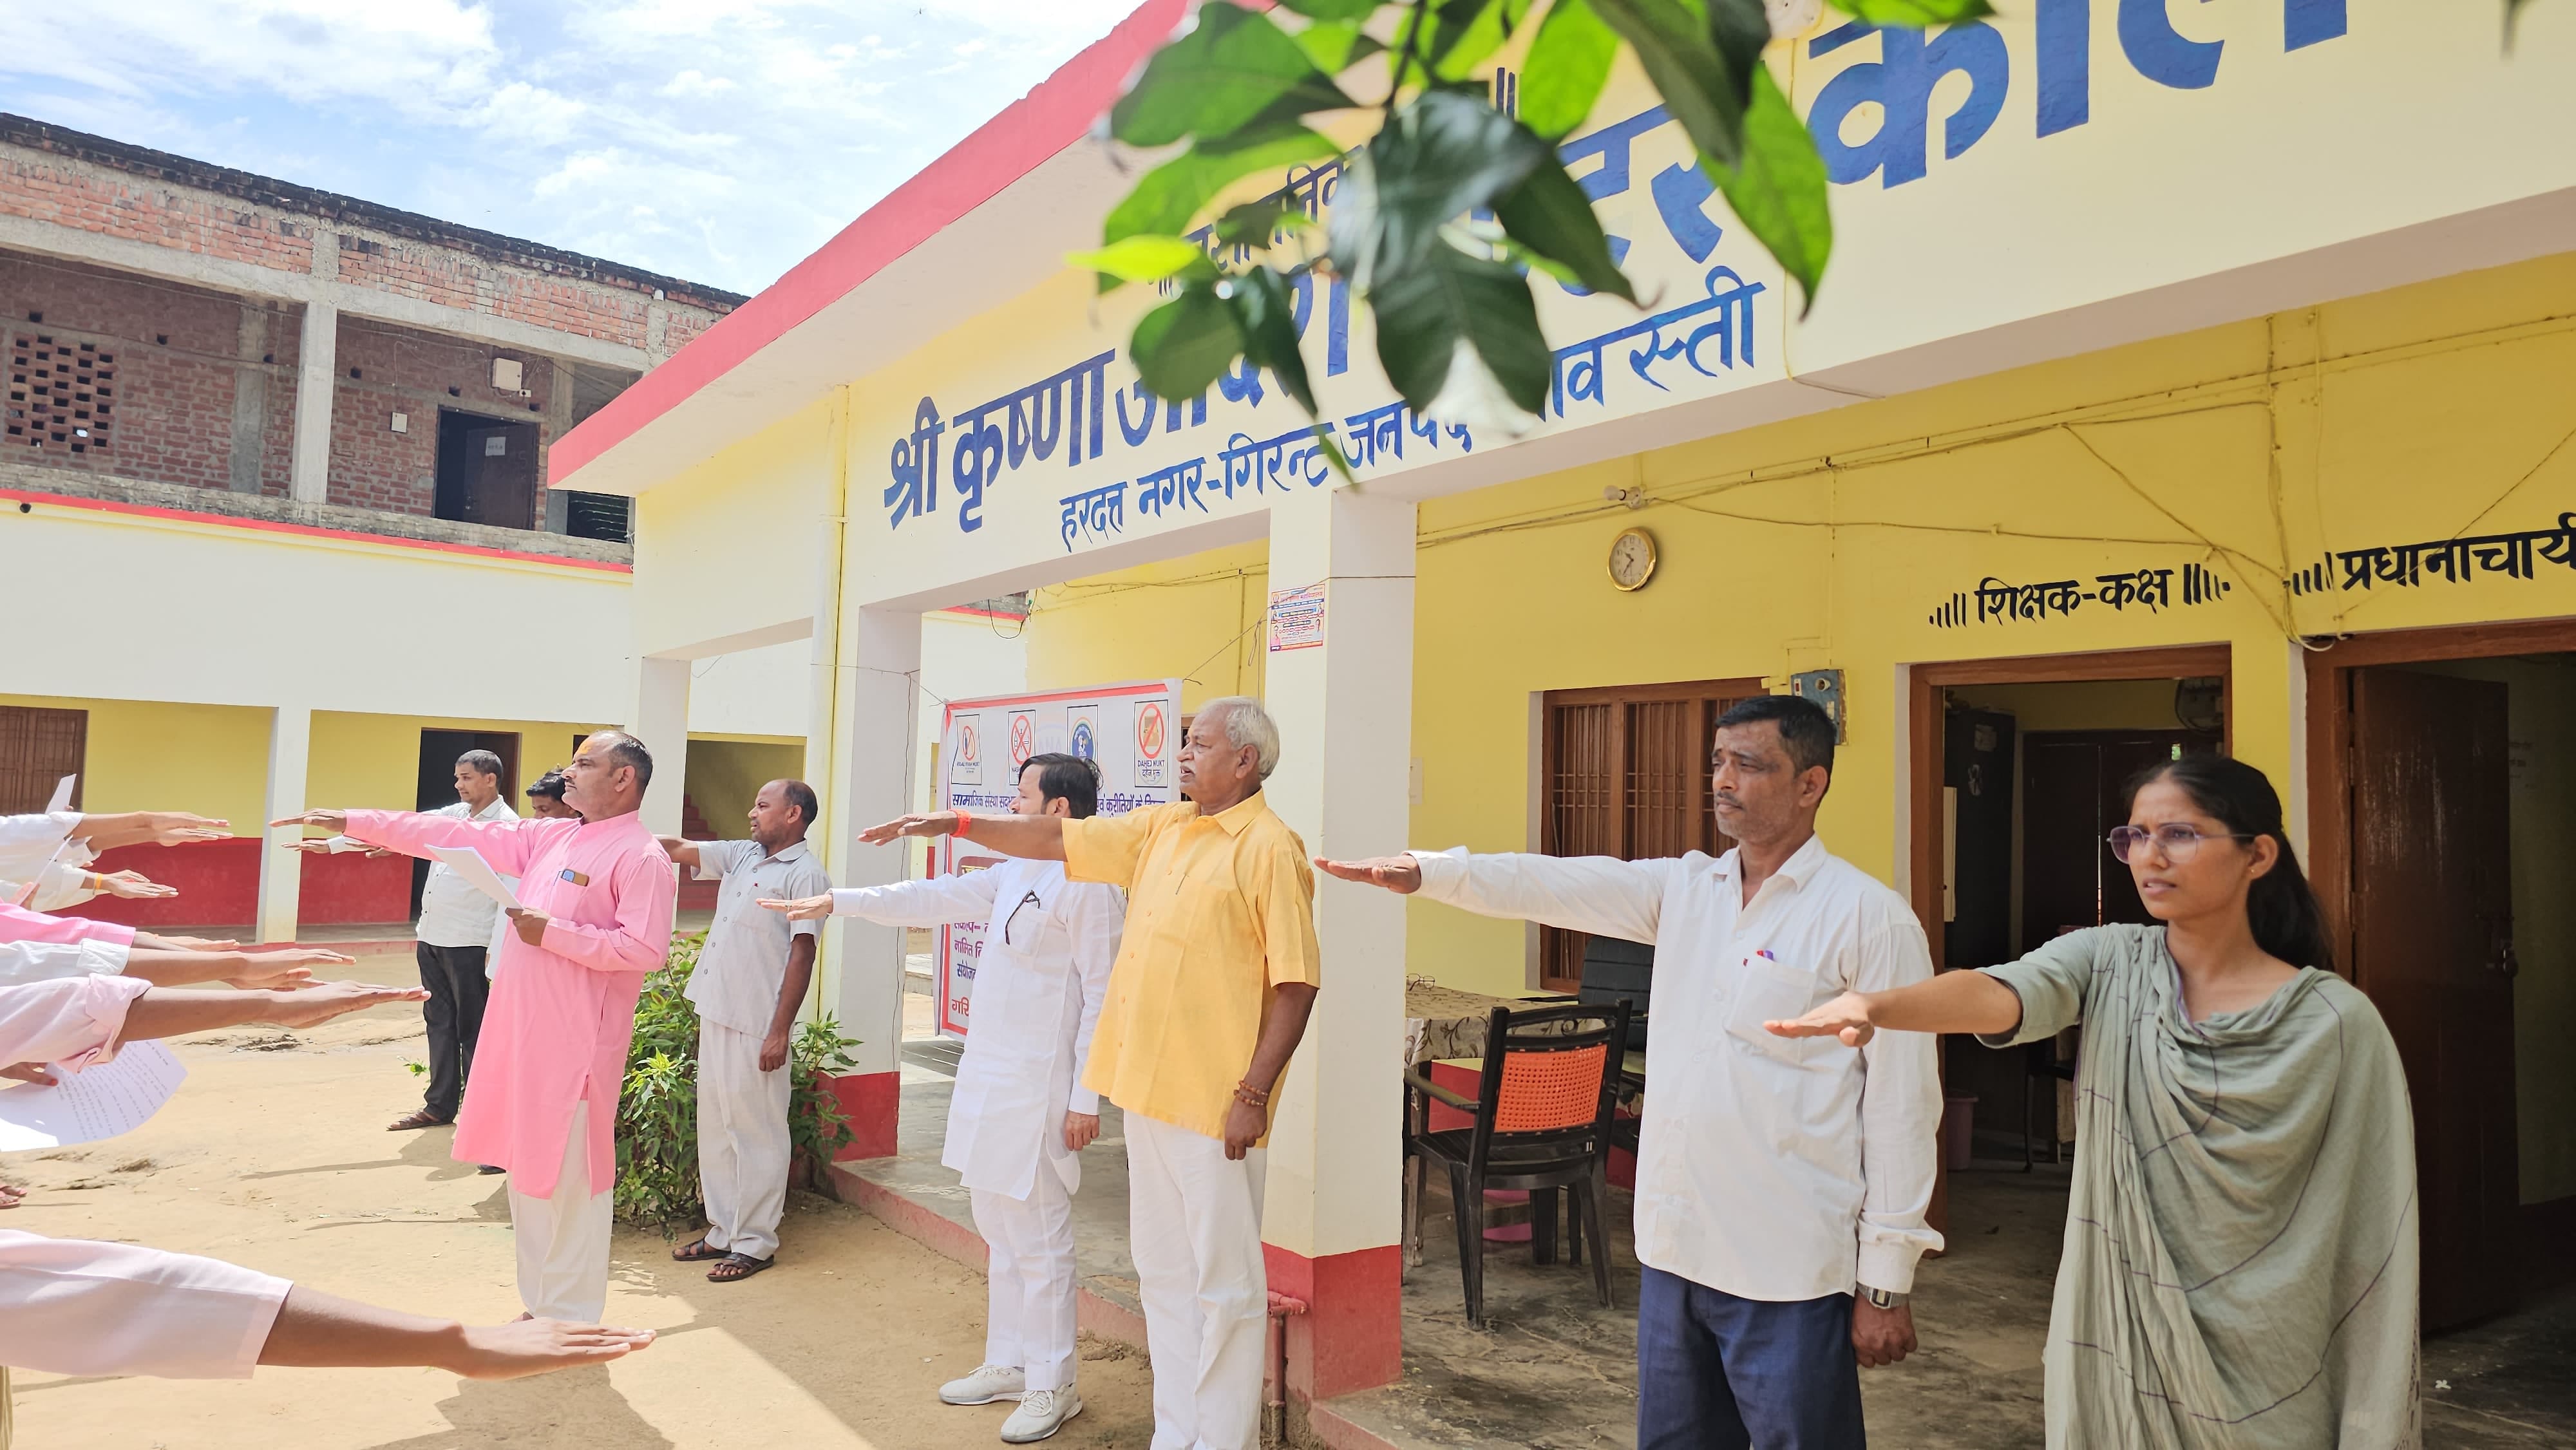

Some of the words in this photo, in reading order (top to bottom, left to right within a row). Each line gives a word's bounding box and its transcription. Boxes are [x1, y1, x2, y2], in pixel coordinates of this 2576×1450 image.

[884, 396, 945, 531] श्री
[953, 348, 1115, 533] कृष्णा
[1059, 481, 1128, 552] हरदत्त
[1975, 569, 2174, 626] शिक्षक-कक्ष
[952, 790, 983, 807] सामाजिक
